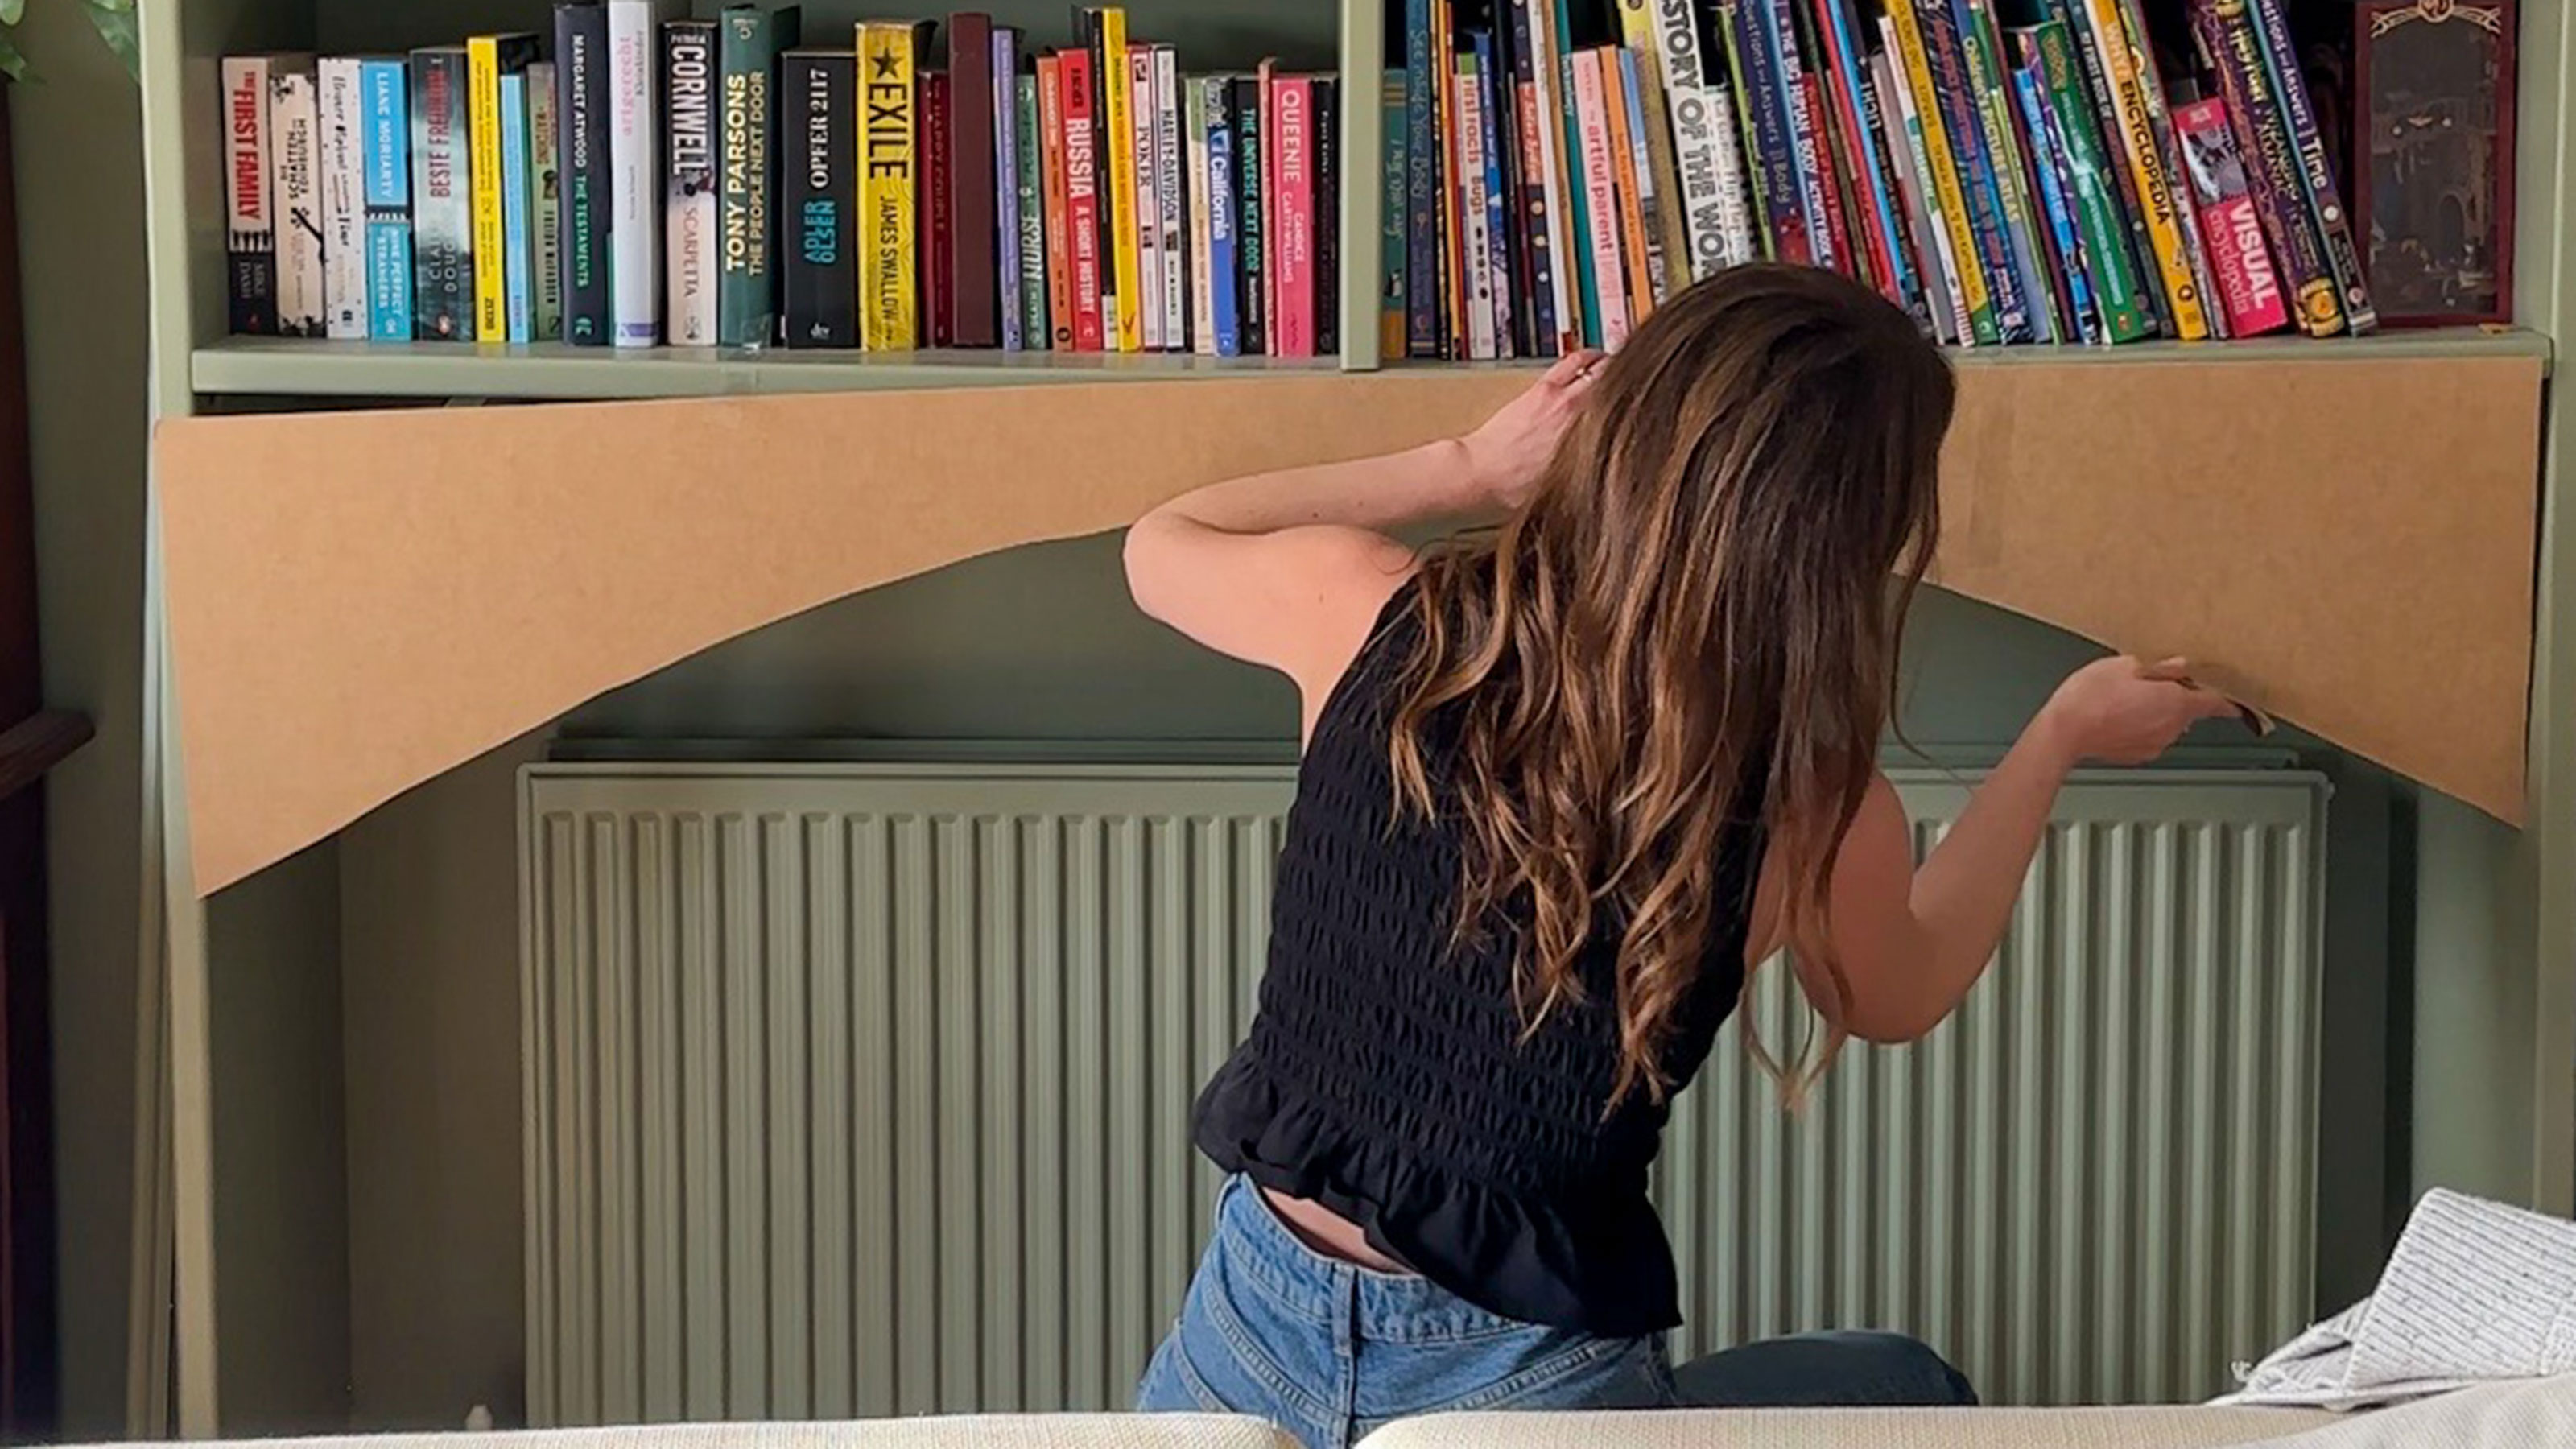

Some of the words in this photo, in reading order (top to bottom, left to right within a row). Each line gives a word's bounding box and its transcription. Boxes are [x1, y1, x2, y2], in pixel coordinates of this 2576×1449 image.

[572, 35, 585, 108] MARGARET
[1410, 29, 1426, 59] See
[1661, 0, 1699, 93] STORY
[1781, 29, 1795, 52] THE
[1784, 55, 1802, 80] BIG
[244, 71, 256, 89] THE
[376, 72, 392, 115] LIANE
[617, 35, 634, 135] artgerecht
[749, 72, 765, 122] DOOR
[810, 69, 829, 111] 2117
[1461, 79, 1479, 112] First
[2083, 43, 2099, 76] FIRST
[2091, 76, 2107, 105] BOOK
[2259, 0, 2290, 52] estions
[2279, 66, 2311, 126] Answers
[2301, 141, 2330, 191] Time
[233, 89, 258, 147] FIRST
[671, 45, 707, 175] CORNWELL
[727, 74, 746, 194] PARSONS
[868, 83, 908, 179] EXILE
[934, 105, 943, 160] HAPPY
[1242, 109, 1256, 134] THE
[1282, 89, 1301, 183] QUEENIE
[1675, 97, 1707, 142] OF
[1790, 83, 1811, 132] HUMAN
[287, 131, 300, 200] SCHATTEN
[378, 122, 394, 199] MORIARTY
[573, 111, 587, 167] ATWOOD
[749, 126, 765, 172] NEXT
[810, 118, 829, 189] OPFER
[1067, 118, 1093, 199] RUSSIA
[1137, 126, 1152, 188] POKER
[1160, 109, 1178, 222] HARLEY-DAVIDSON
[1242, 137, 1257, 199] UNIVERSE
[1463, 116, 1482, 163] Facts
[1585, 124, 1608, 182] artful
[1757, 85, 1780, 143] Answers
[1769, 162, 1790, 204] Body
[1798, 137, 1818, 175] BODY
[1979, 107, 2009, 172] PICTURE
[1996, 175, 2022, 223] ATLAS
[2118, 78, 2173, 225] ENCYCLOPEDIA
[2254, 122, 2289, 198] ALMANAC
[2263, 105, 2302, 202] WIZARDING
[237, 151, 262, 221] FAMILY
[428, 151, 452, 198] BESTE
[576, 175, 588, 200] THE
[934, 167, 945, 231] COUPLE
[1211, 156, 1229, 241] California
[1468, 175, 1485, 214] Bugs
[1683, 144, 1715, 199] THE
[749, 175, 765, 241] PEOPLE
[804, 201, 820, 262] ADLER
[819, 200, 836, 263] OLSEN
[879, 195, 898, 244] JAMES
[1075, 206, 1089, 217] A
[1244, 200, 1258, 234] NEXT
[1591, 185, 1615, 250] parent
[1806, 179, 1827, 227] ACTIVITY
[576, 204, 589, 287] TESTAMENTS
[683, 207, 699, 298] SCARPETTA
[727, 202, 745, 271] TONY
[749, 245, 765, 275] THE
[1021, 213, 1043, 281] NURSE
[1076, 218, 1092, 258] SHORT
[1245, 237, 1259, 272] DOOR
[1282, 191, 1294, 283] CARTY-WILLIAMS
[1294, 212, 1305, 262] CANDICE
[1692, 201, 1728, 278] WOR
[1816, 228, 1832, 257] BOOK
[2207, 210, 2248, 315] encyclopedia
[2227, 200, 2268, 309] VISUAL
[239, 262, 253, 299] DASH
[377, 236, 391, 308] STRANGERS
[390, 261, 406, 316] PERFECT
[880, 248, 899, 320] SWALLOW
[1079, 261, 1094, 314] HISTORY
